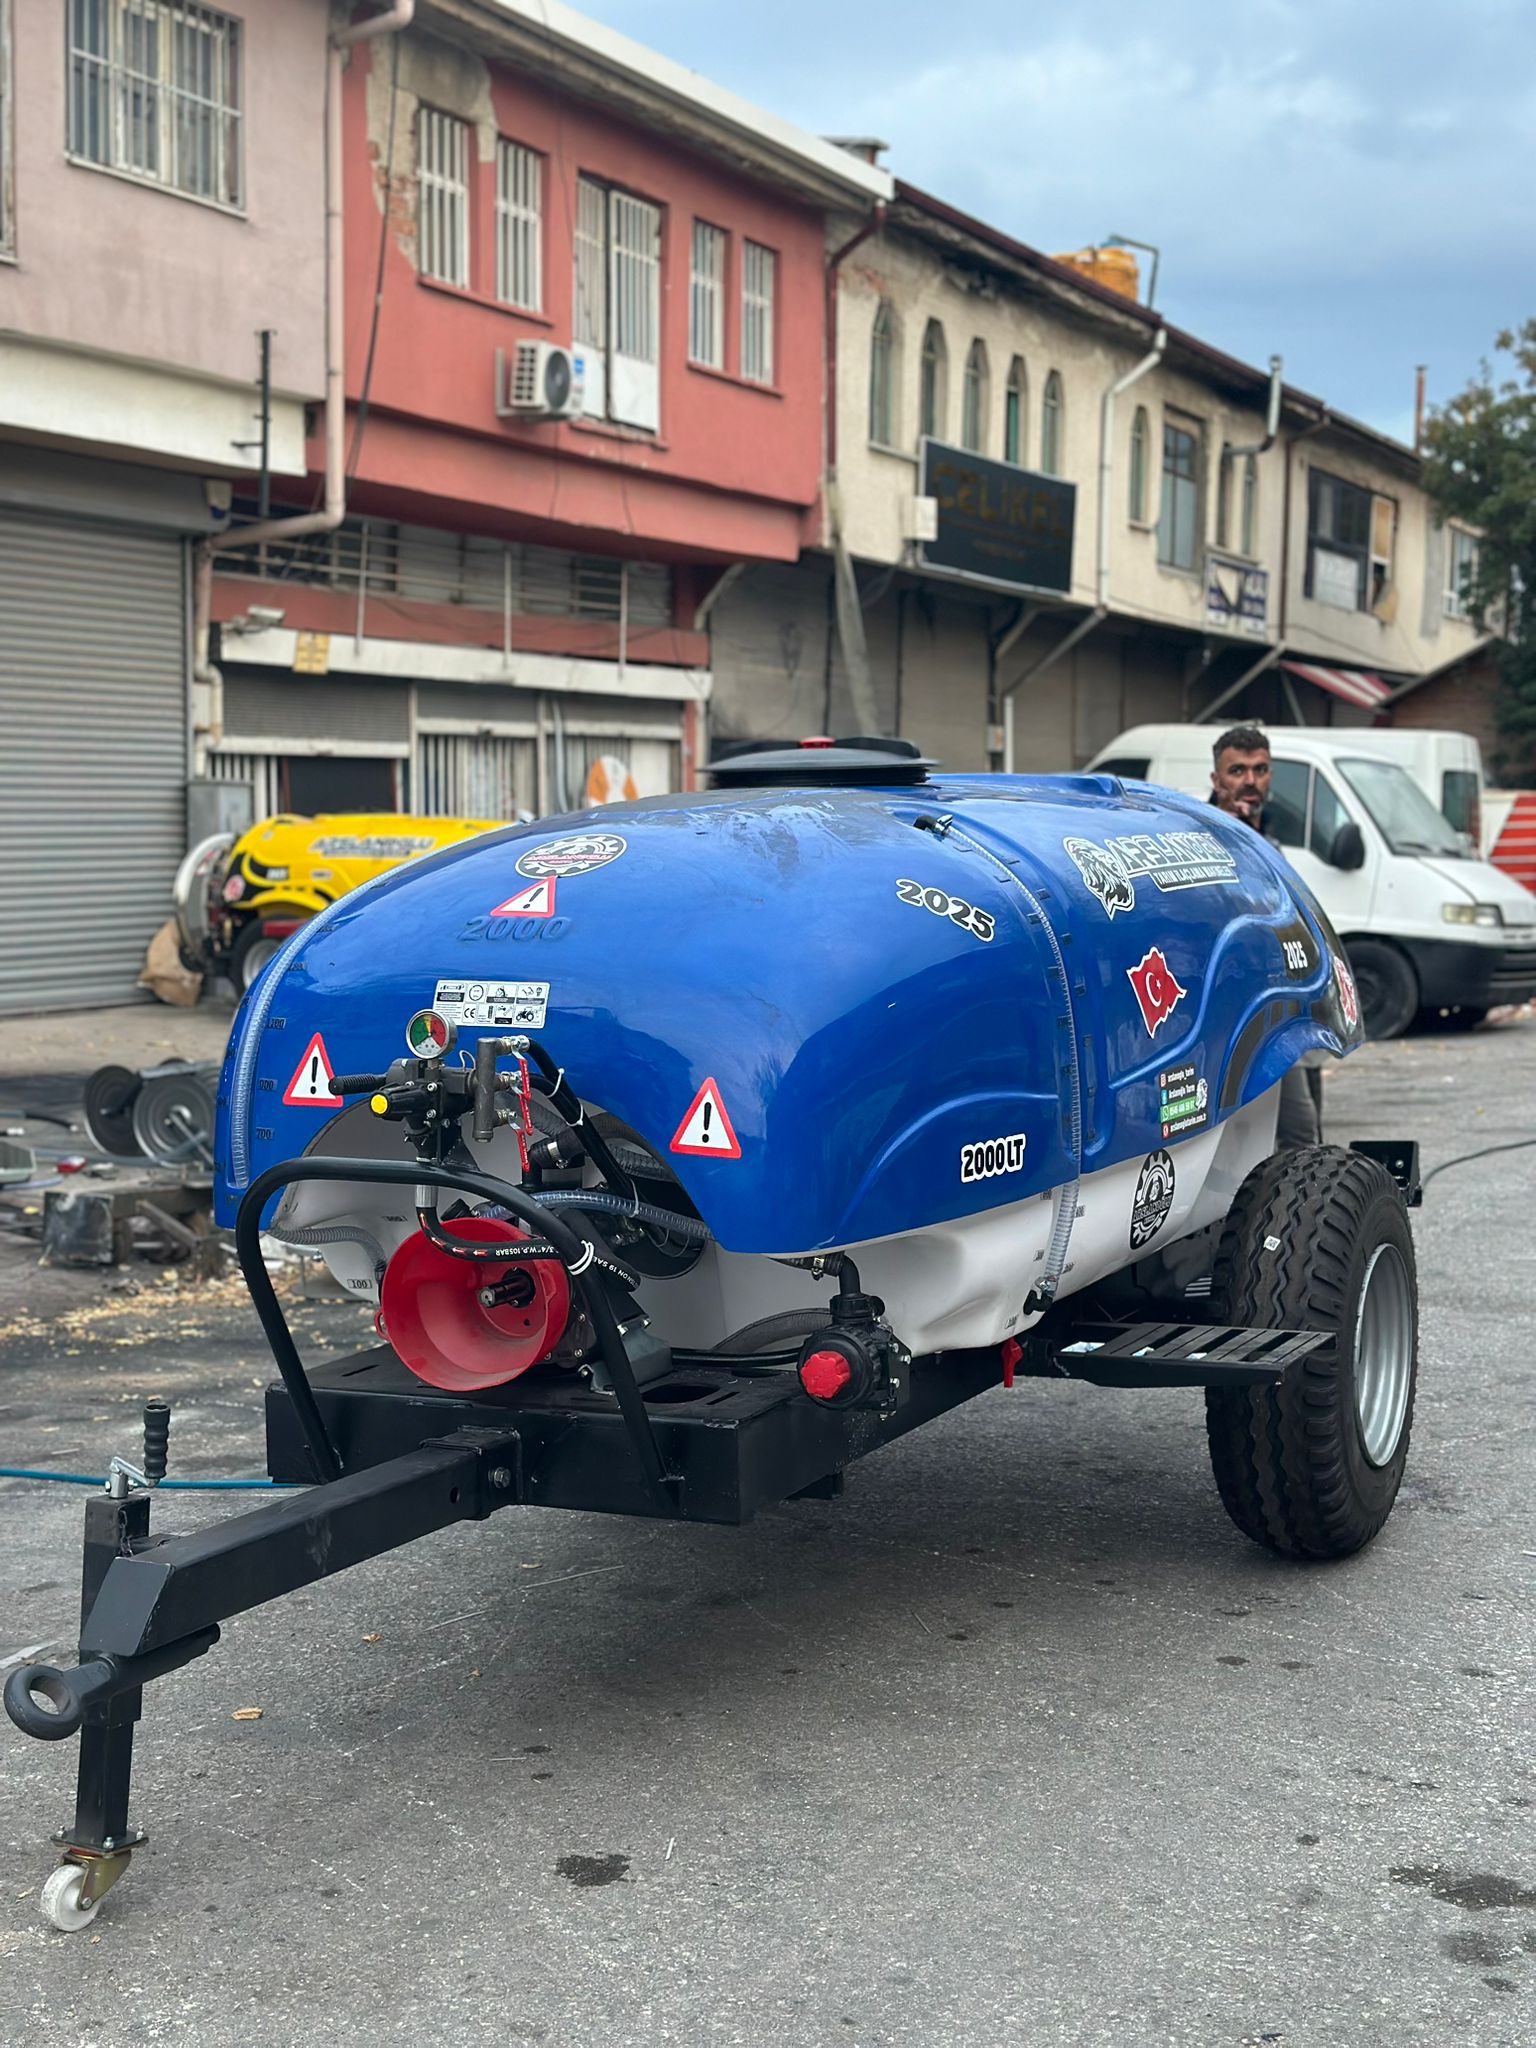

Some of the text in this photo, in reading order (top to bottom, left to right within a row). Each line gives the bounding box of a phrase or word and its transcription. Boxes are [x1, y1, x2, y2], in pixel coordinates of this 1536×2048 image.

[897, 880, 994, 940] 2025
[456, 915, 571, 941] 2000
[1283, 941, 1308, 969] 2025
[608, 1264, 617, 1273] 19
[618, 1269, 629, 1280] DN
[352, 1280, 368, 1288] 100
